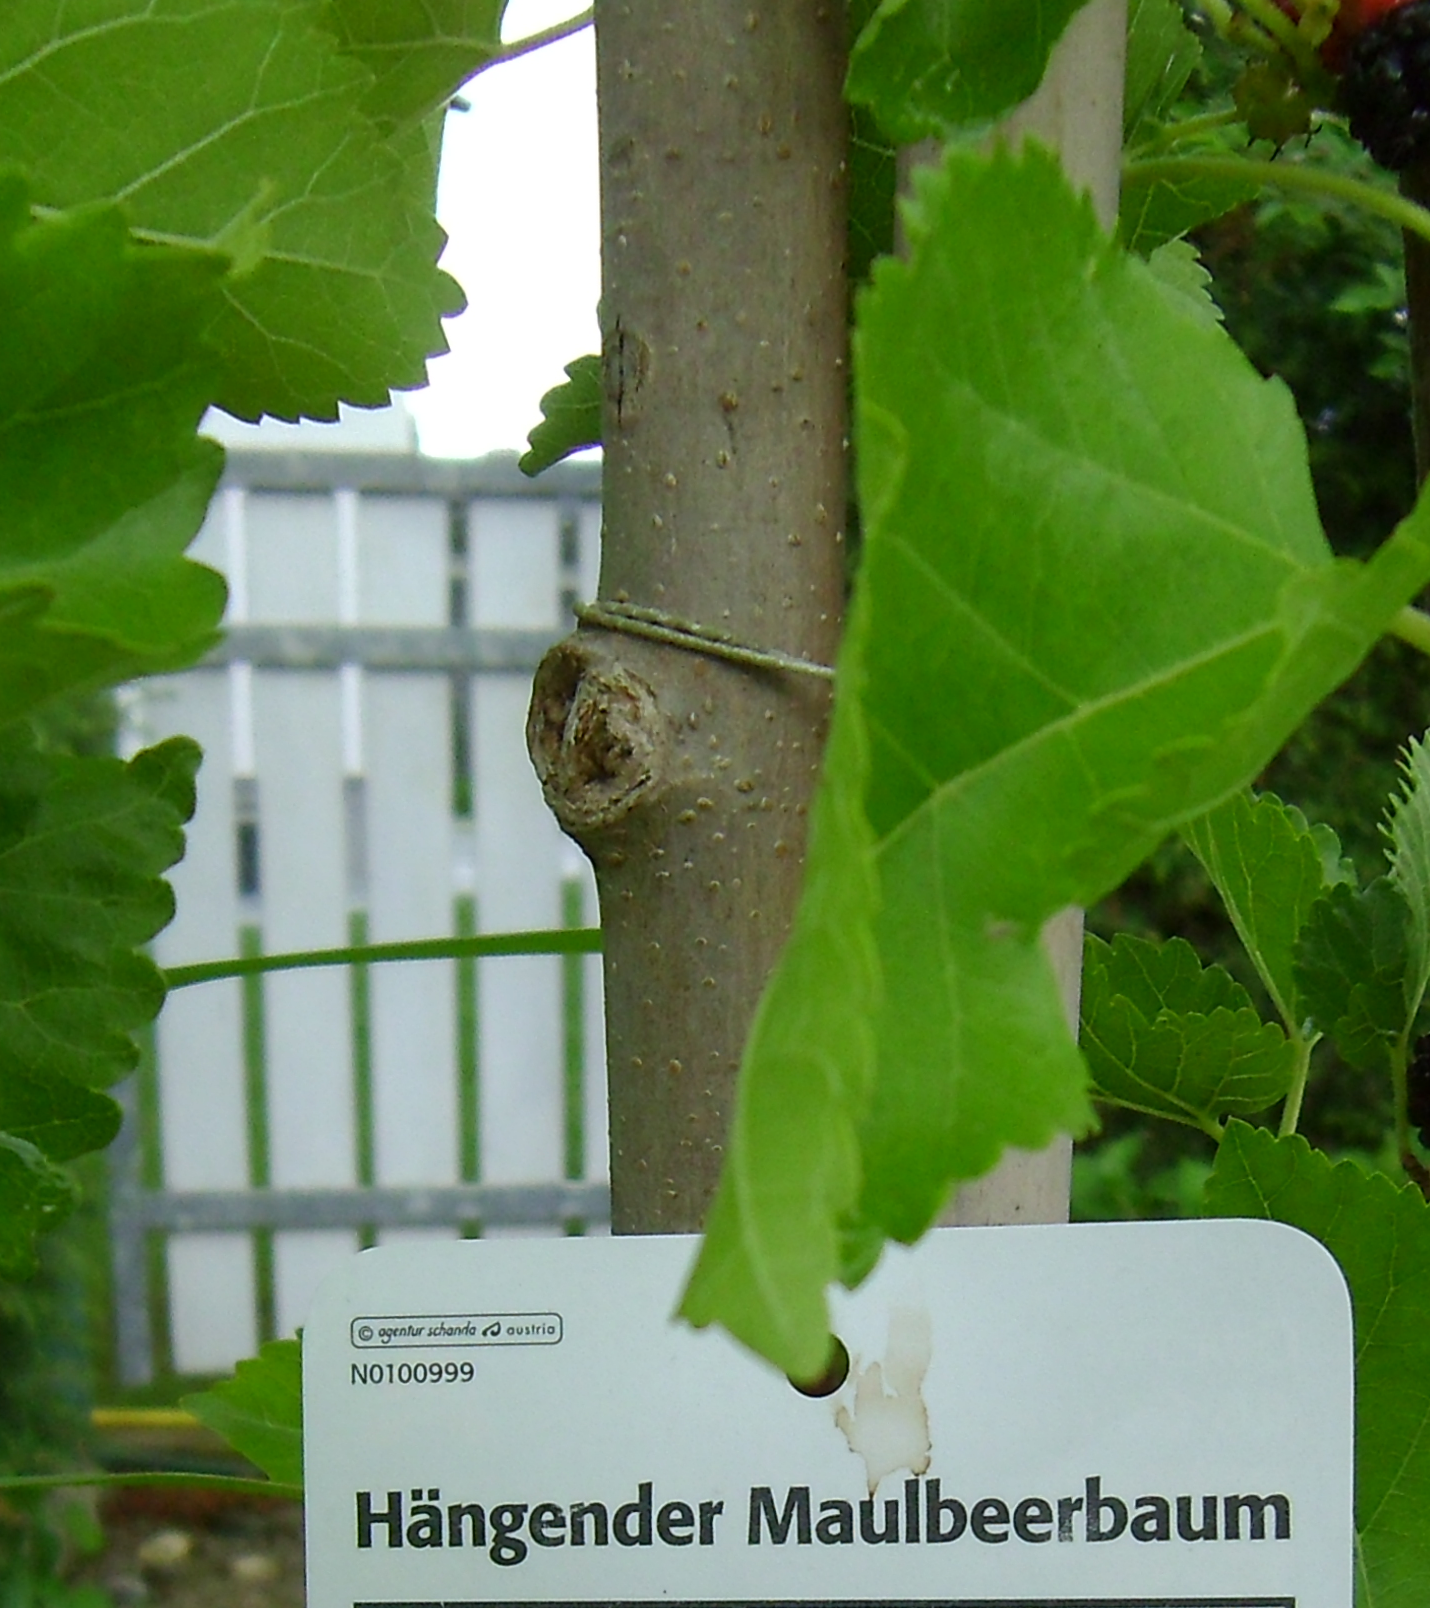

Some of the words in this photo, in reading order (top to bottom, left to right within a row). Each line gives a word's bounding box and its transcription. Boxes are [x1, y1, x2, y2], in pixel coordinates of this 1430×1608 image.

[378, 1324, 425, 1345] agentur
[427, 1321, 477, 1337] schanda
[506, 1324, 555, 1336] austria
[351, 1362, 474, 1385] N0100999
[355, 1482, 724, 1567] Hängender
[747, 1476, 1291, 1546] Maulbeerbaum
